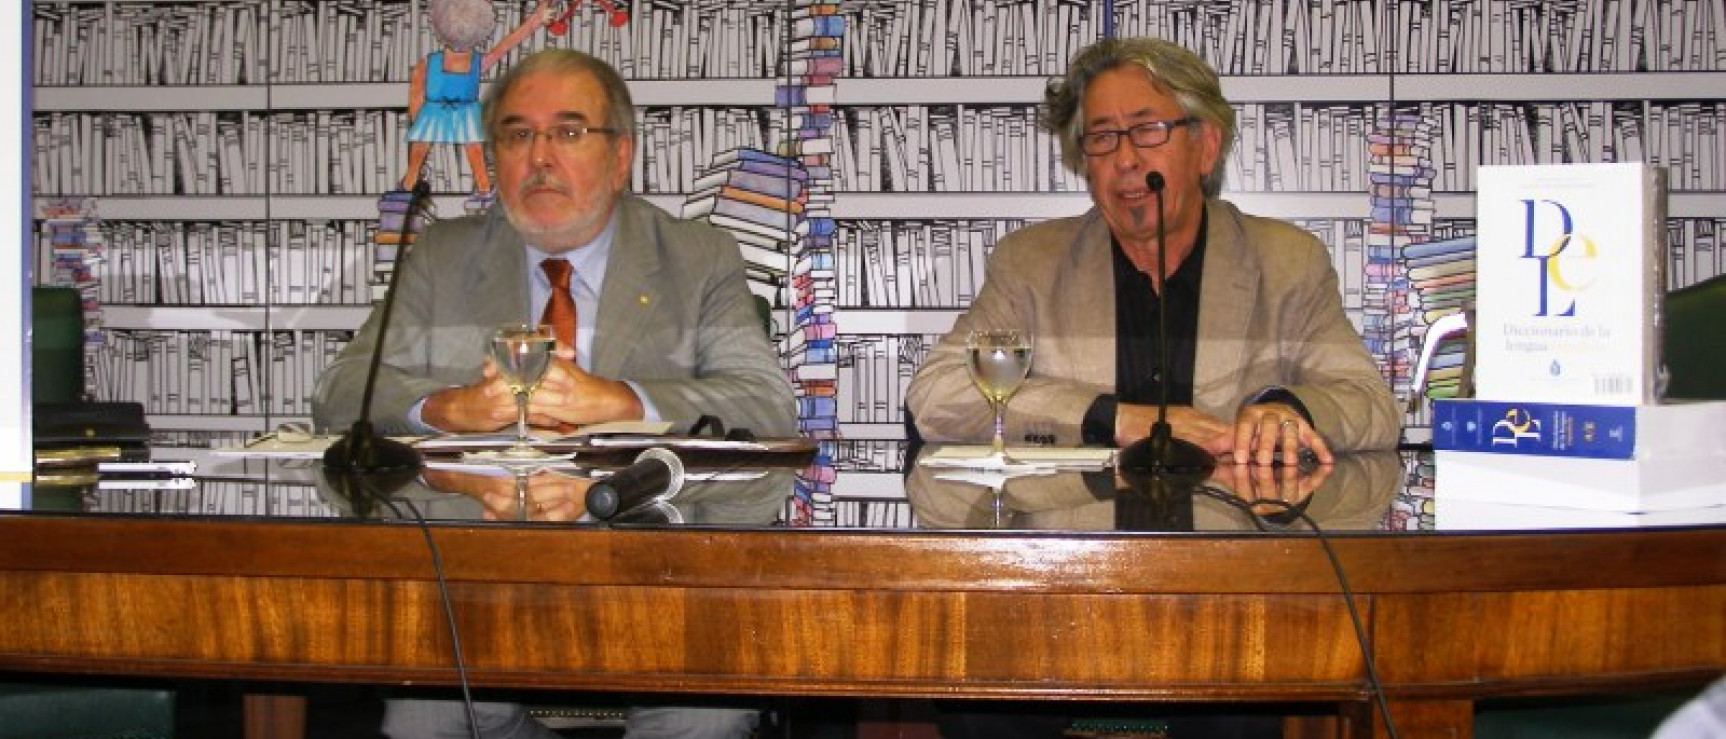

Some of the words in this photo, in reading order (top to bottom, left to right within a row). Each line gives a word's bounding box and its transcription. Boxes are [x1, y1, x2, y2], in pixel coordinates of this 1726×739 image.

[1503, 322, 1577, 337] Diccionario
[1581, 323, 1595, 337] de
[1598, 324, 1611, 338] la
